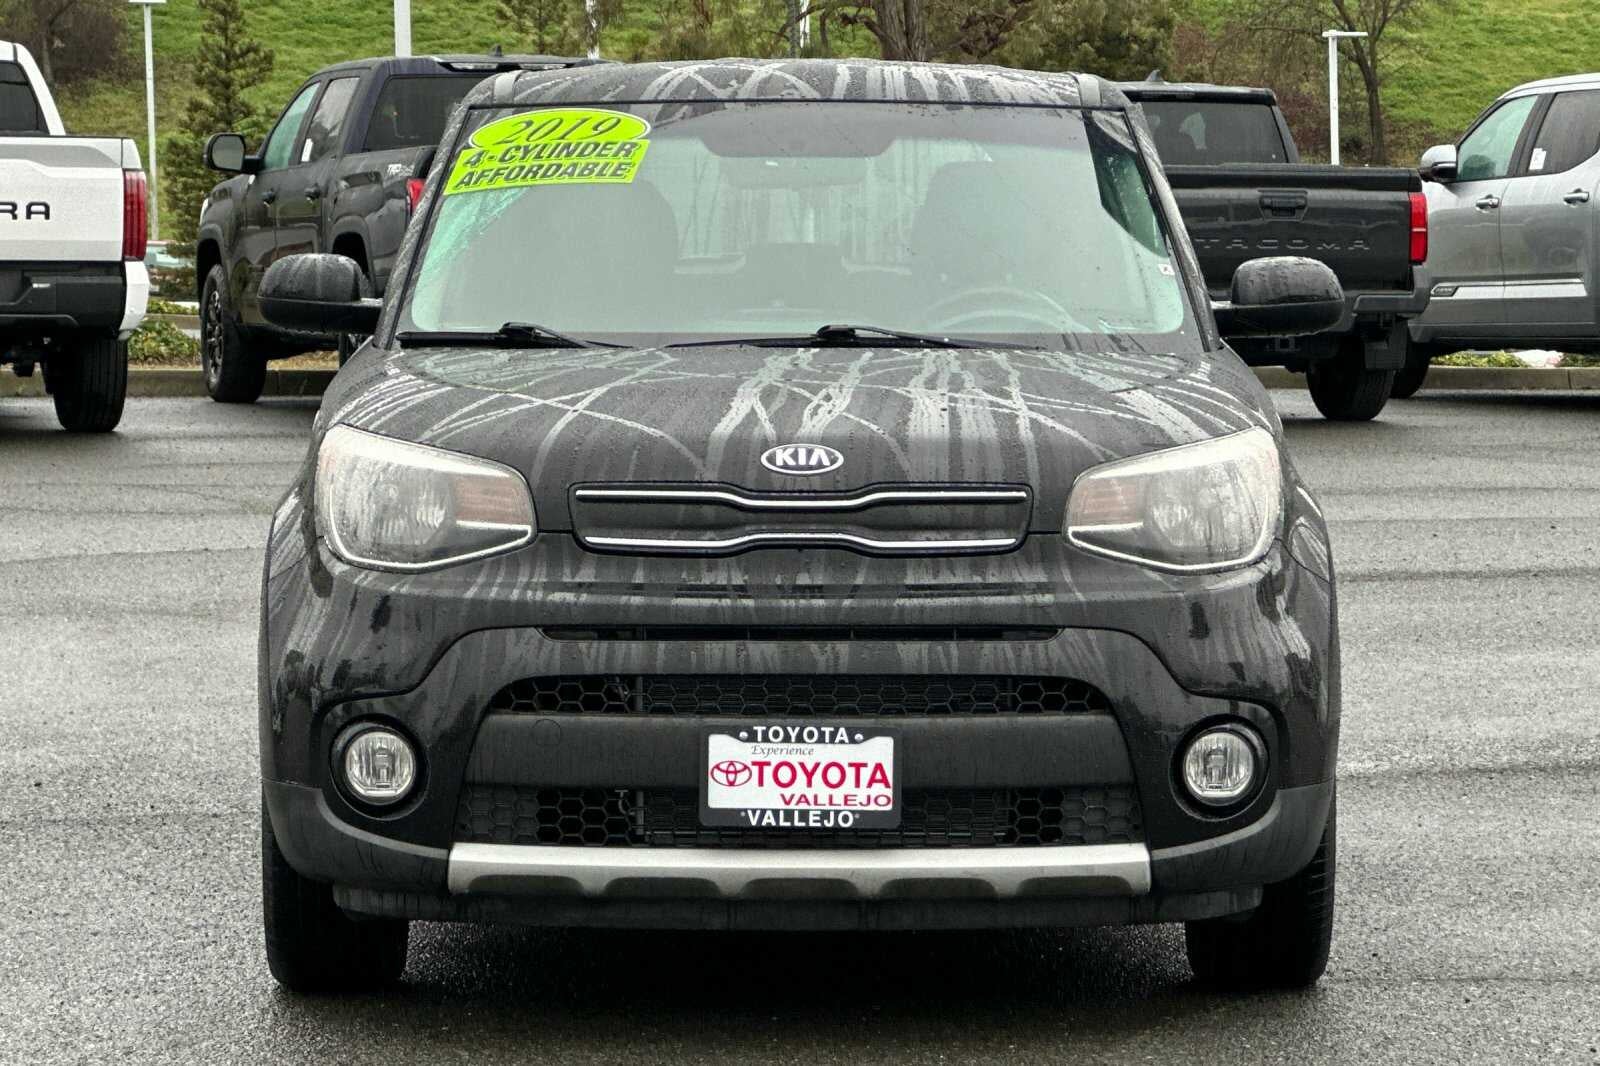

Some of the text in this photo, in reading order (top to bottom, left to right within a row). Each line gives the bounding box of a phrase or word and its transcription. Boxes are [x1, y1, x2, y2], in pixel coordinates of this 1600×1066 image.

[494, 116, 622, 146] 2019
[464, 140, 641, 168] 4-CYLINDER
[453, 161, 635, 189] AFFORDABLE
[775, 447, 831, 466] KIA
[753, 726, 849, 743] TOYOTA
[751, 744, 815, 758] Experience
[751, 760, 891, 789] TOYOTA
[780, 793, 892, 807] VALLEJO
[747, 809, 853, 827] VALLEJO
